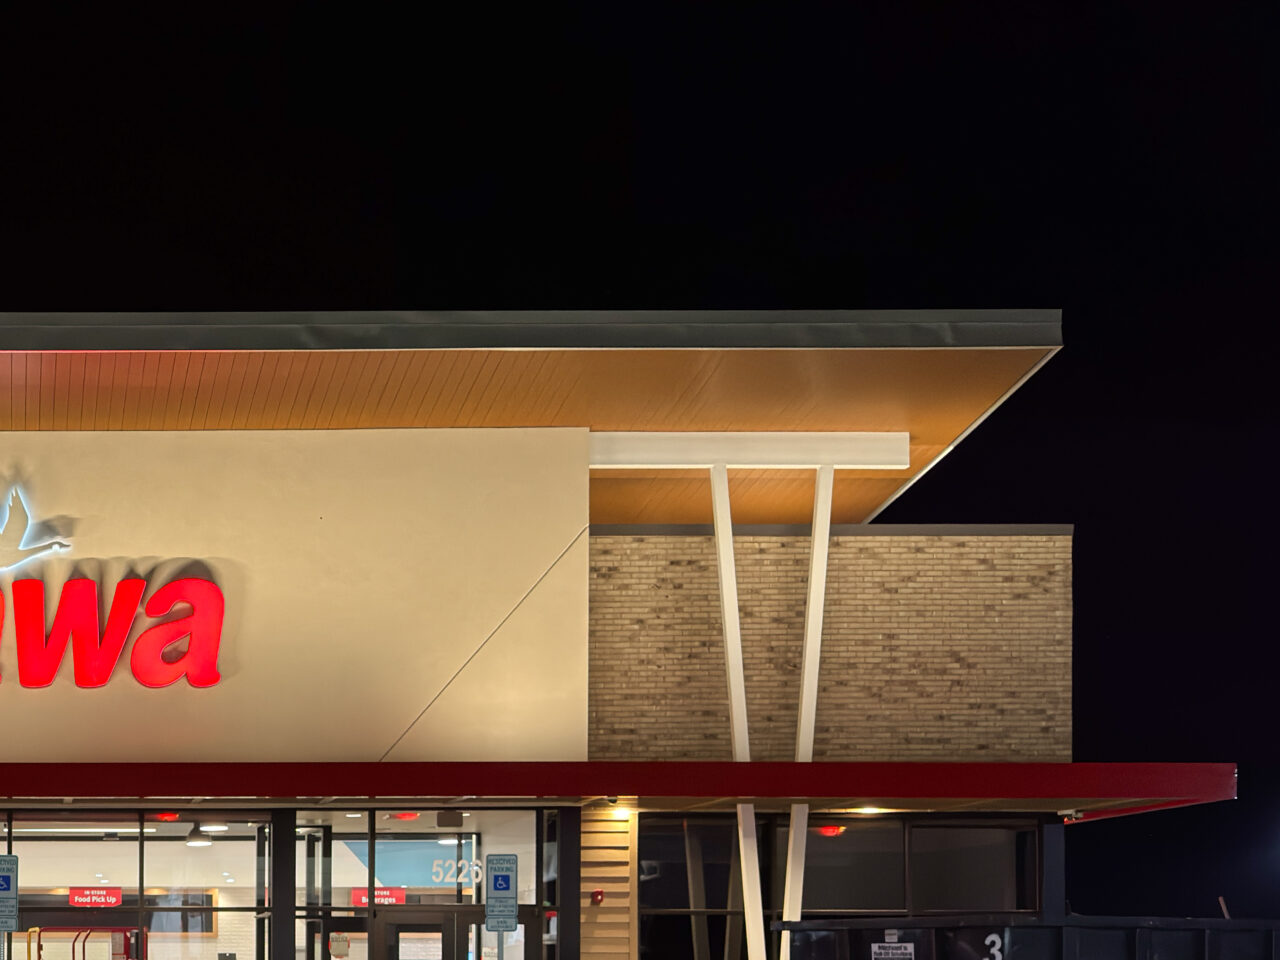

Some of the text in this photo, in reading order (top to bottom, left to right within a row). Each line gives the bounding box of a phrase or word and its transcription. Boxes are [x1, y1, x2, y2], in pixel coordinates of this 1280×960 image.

[431, 859, 483, 883] 5226
[106, 896, 117, 904] Up
[361, 896, 396, 905] Beerages
